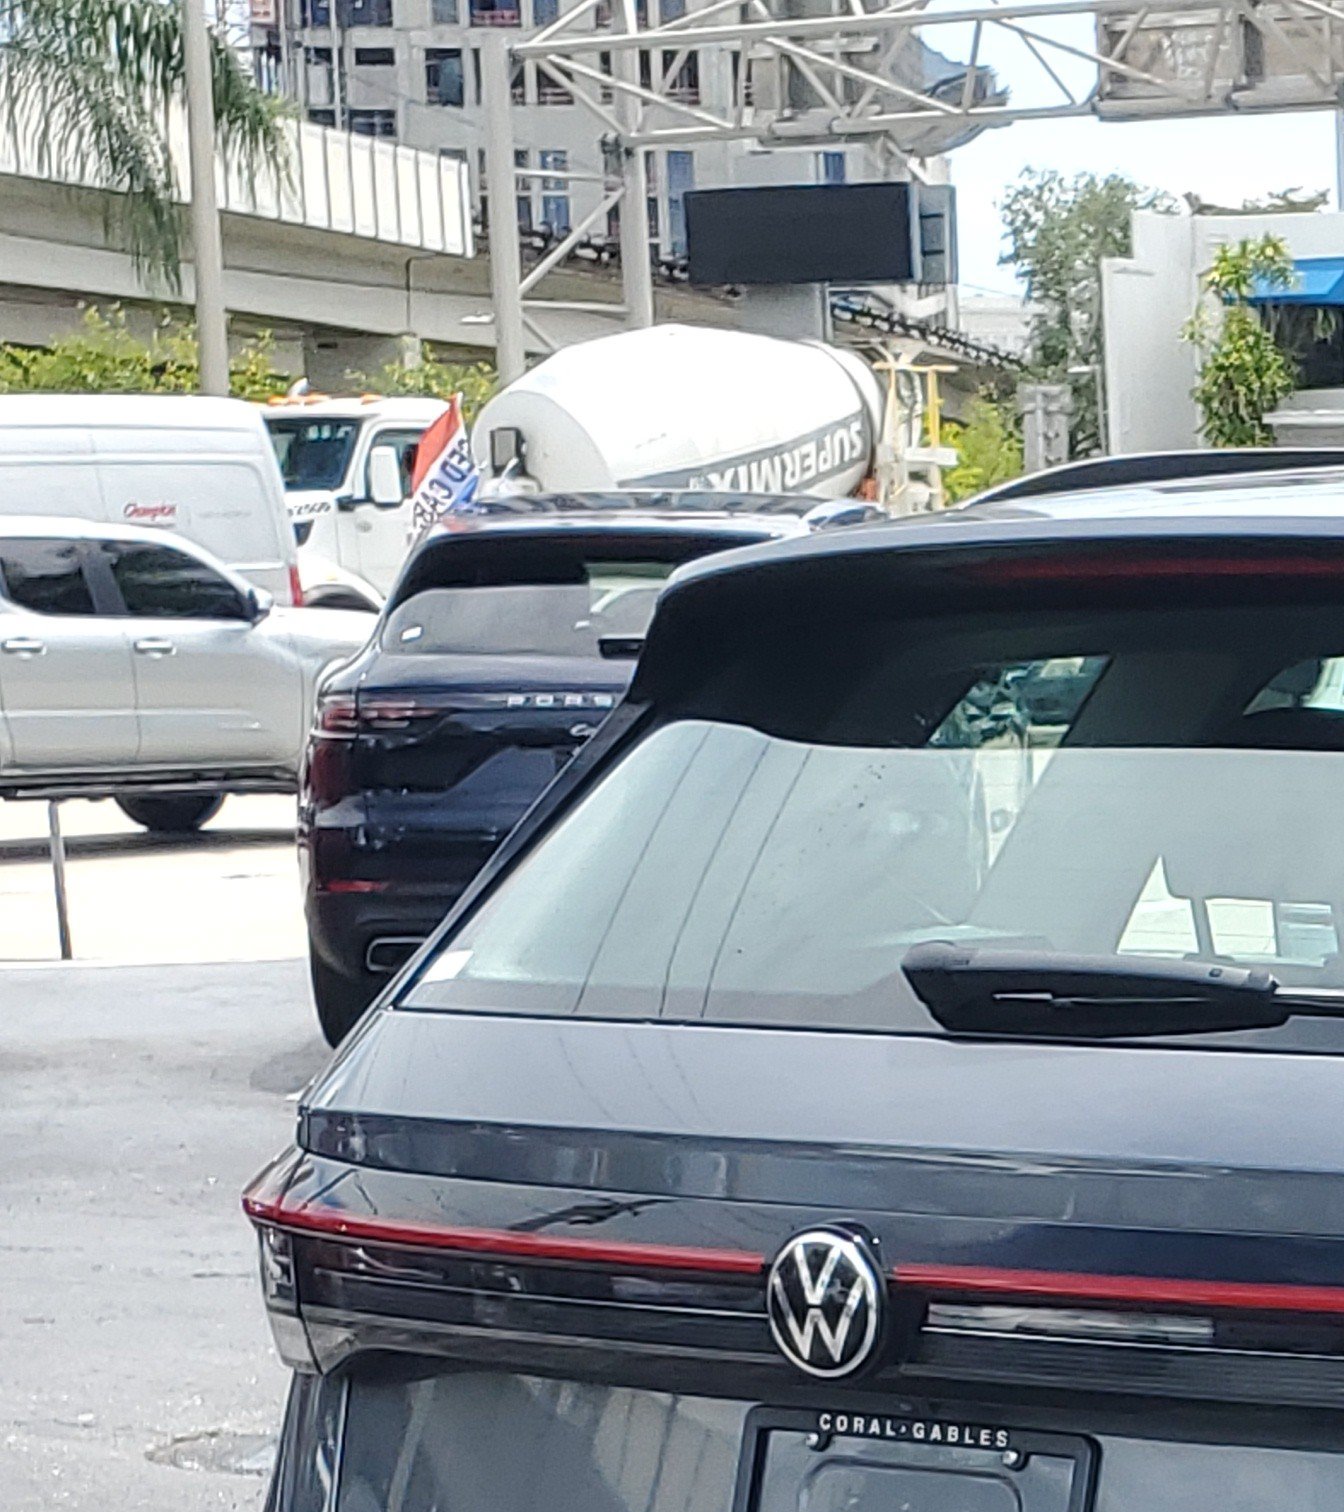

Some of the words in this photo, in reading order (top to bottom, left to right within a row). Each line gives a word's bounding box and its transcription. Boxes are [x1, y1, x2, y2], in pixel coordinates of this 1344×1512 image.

[706, 420, 863, 493] SUPERMIX
[770, 1236, 874, 1373] VW
[819, 1413, 896, 1436] CORAL
[912, 1422, 1009, 1447] GABLES
